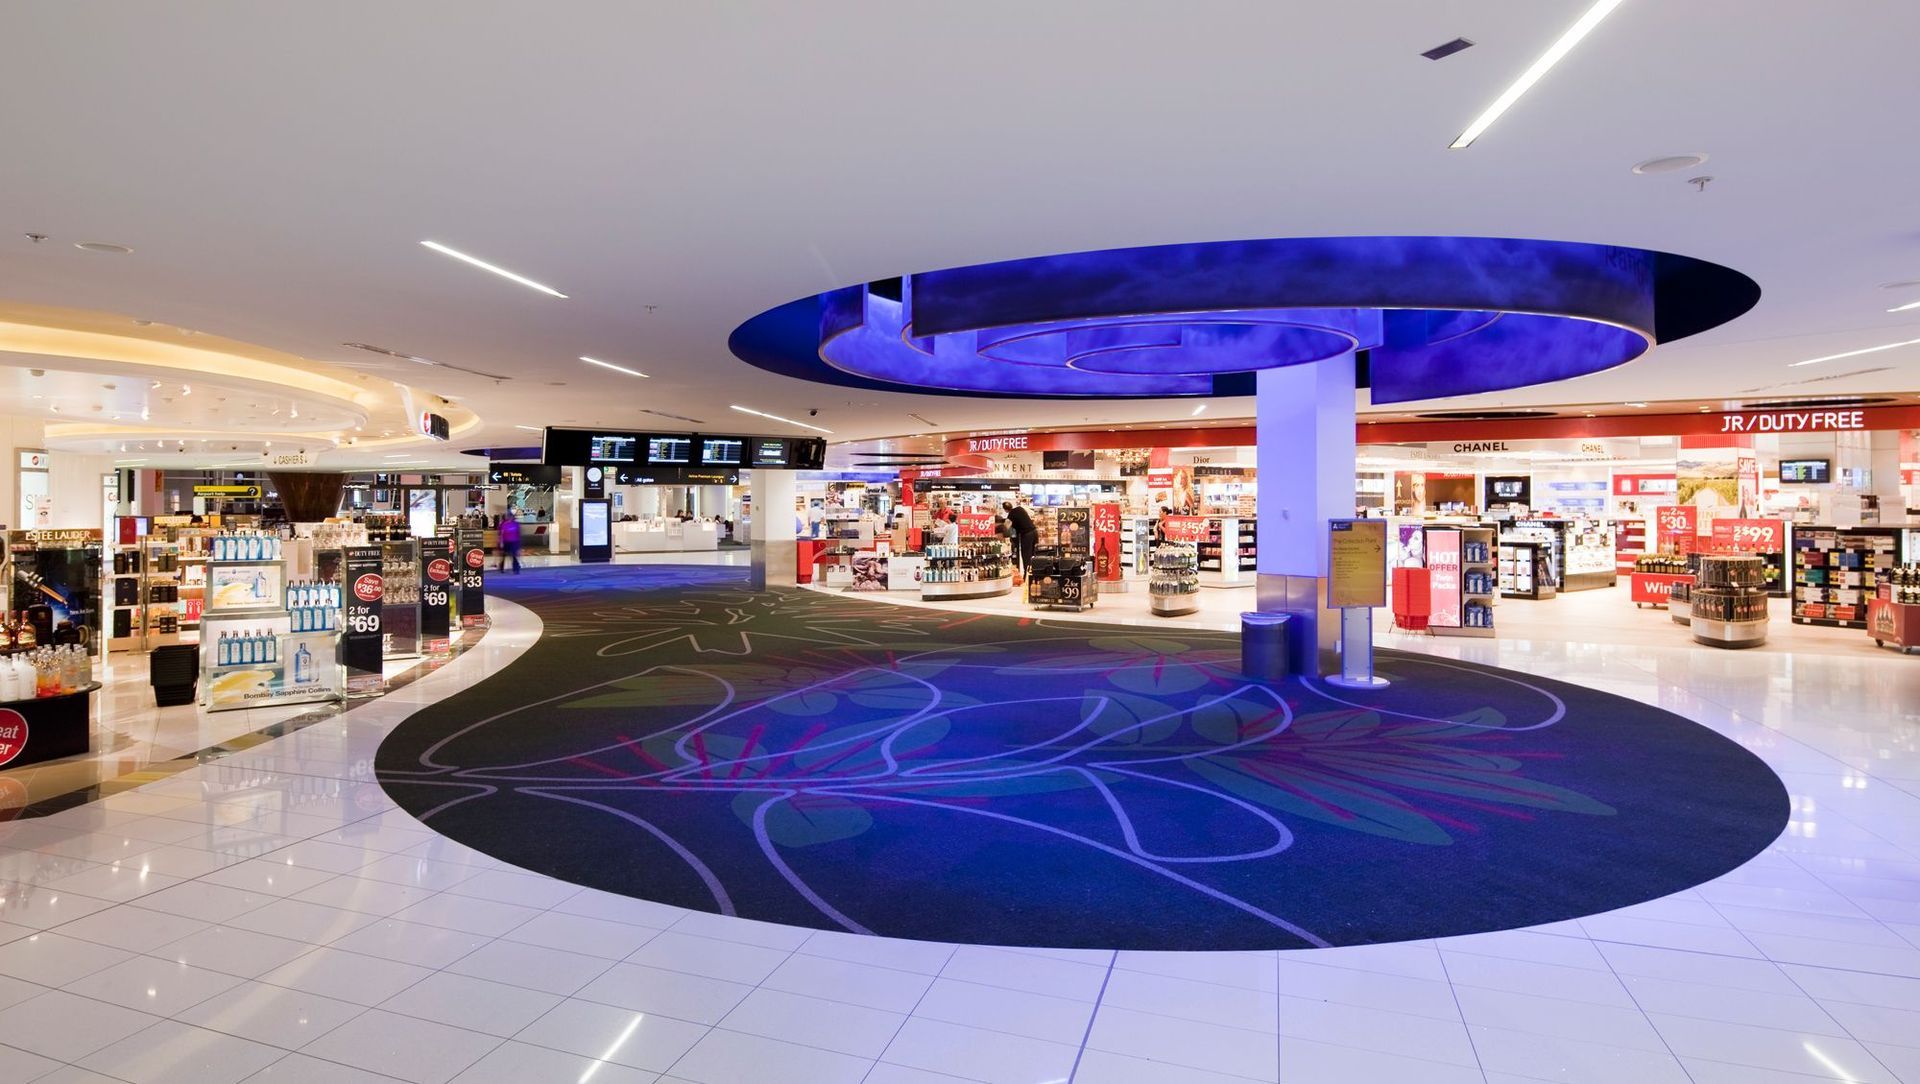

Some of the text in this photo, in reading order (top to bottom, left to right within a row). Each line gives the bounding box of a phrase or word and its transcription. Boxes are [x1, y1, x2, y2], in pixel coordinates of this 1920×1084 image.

[1453, 442, 1509, 453] CHANEL
[1581, 443, 1604, 454] CHANEL
[1193, 456, 1210, 464] Dior
[994, 463, 1033, 473] NMENT
[1738, 459, 1756, 473] SAVE
[1099, 508, 1107, 519] 2
[1671, 507, 1677, 515] 2
[1060, 512, 1066, 522] 2
[1095, 520, 1116, 533] $45
[1660, 516, 1687, 530] $30
[54, 530, 91, 540] LAUDER
[1741, 526, 1774, 543] $99
[1429, 551, 1458, 561] HOT
[1429, 563, 1458, 571] OFFER
[363, 577, 379, 585] Save
[463, 576, 483, 588] $33
[1064, 578, 1070, 587] 2
[423, 584, 439, 592] 2 for
[1062, 587, 1080, 599] $99
[1645, 581, 1672, 594] Win
[423, 591, 448, 606] $69
[349, 605, 370, 615] 2 for
[348, 615, 380, 633] $69
[243, 686, 332, 700] Bombay Sapphire Collins
[0, 725, 19, 739] eat
